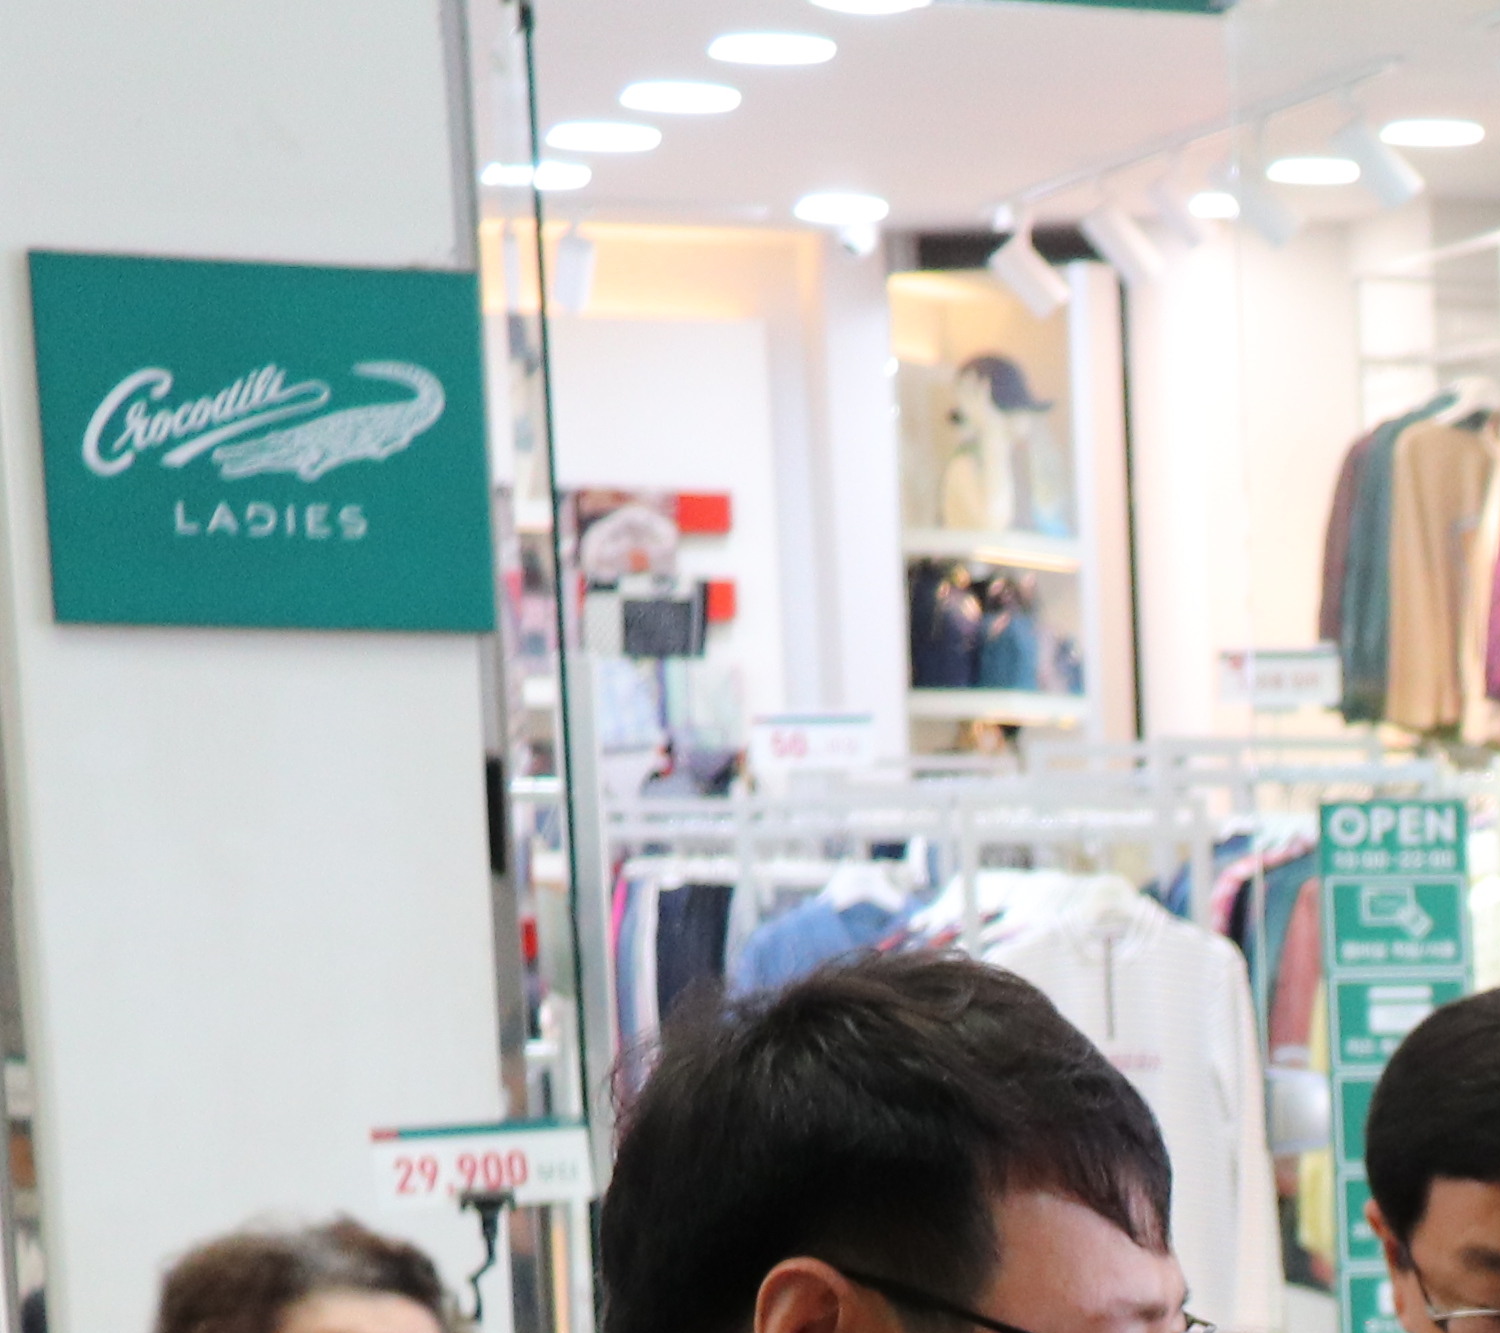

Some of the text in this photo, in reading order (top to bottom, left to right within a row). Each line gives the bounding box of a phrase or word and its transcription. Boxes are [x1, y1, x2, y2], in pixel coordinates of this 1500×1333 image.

[82, 363, 330, 477] Crocodile
[173, 499, 368, 541] LADIES
[1328, 804, 1458, 847] OPEN
[393, 1149, 528, 1195] 29,900
